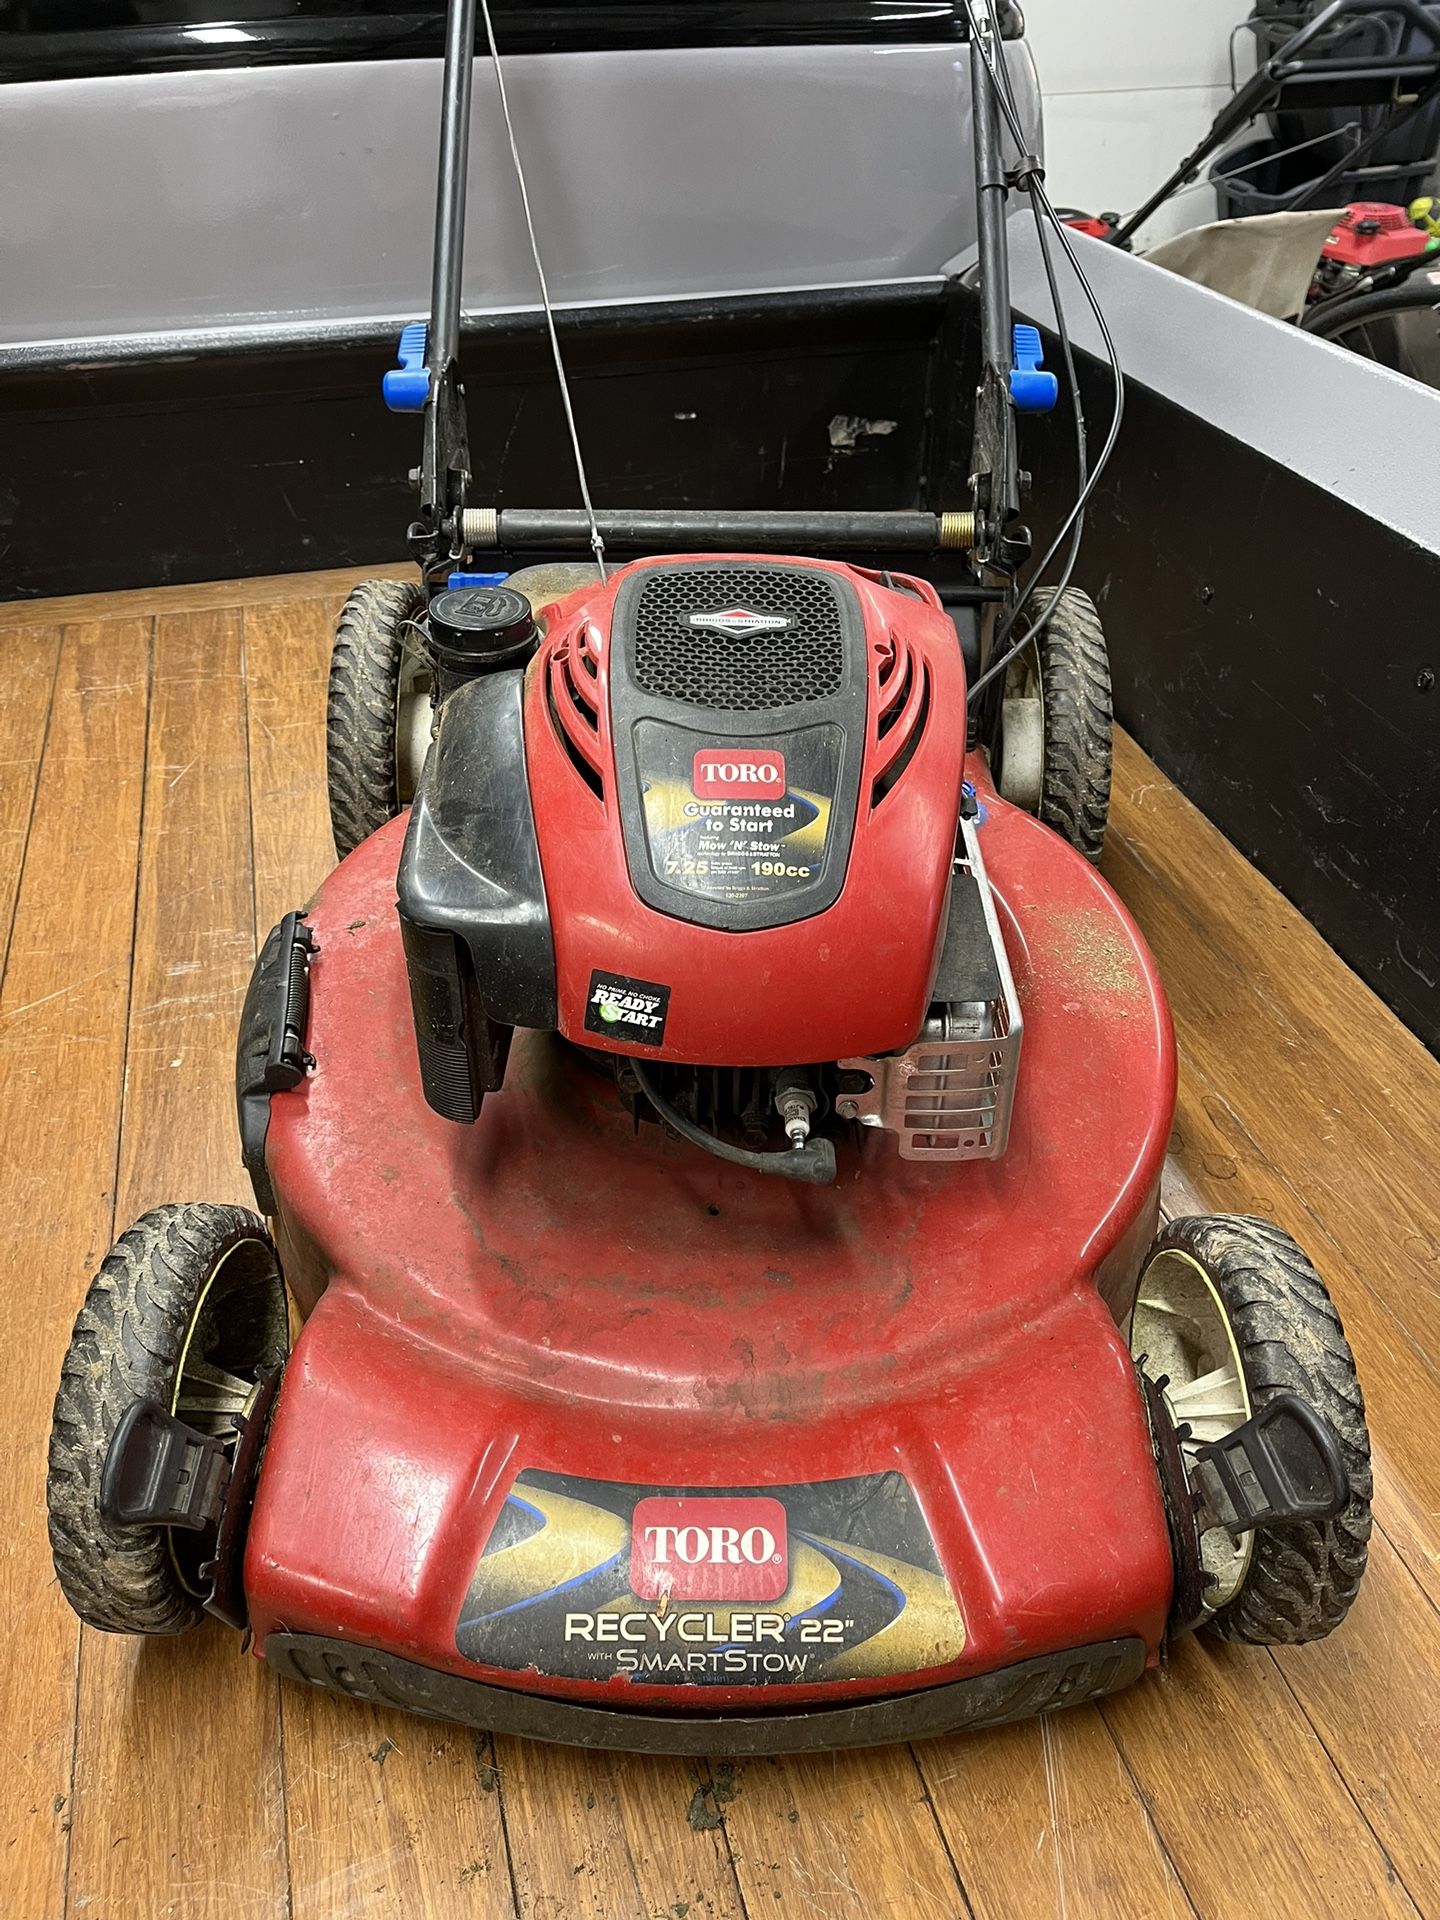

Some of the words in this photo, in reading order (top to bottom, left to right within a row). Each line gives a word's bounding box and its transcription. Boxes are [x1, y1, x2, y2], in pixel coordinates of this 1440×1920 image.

[701, 763, 778, 783] TORO
[684, 803, 795, 818] Guaranteed
[706, 819, 724, 832] to
[729, 817, 774, 833] Start
[698, 840, 727, 851] Mow
[750, 841, 780, 852] Stow
[665, 861, 709, 875] 7.25
[751, 862, 810, 878] 190cc
[591, 989, 659, 1014] READY
[645, 1526, 775, 1564] TORO
[565, 1613, 785, 1642] RECYCLER
[800, 1619, 854, 1643] 22"
